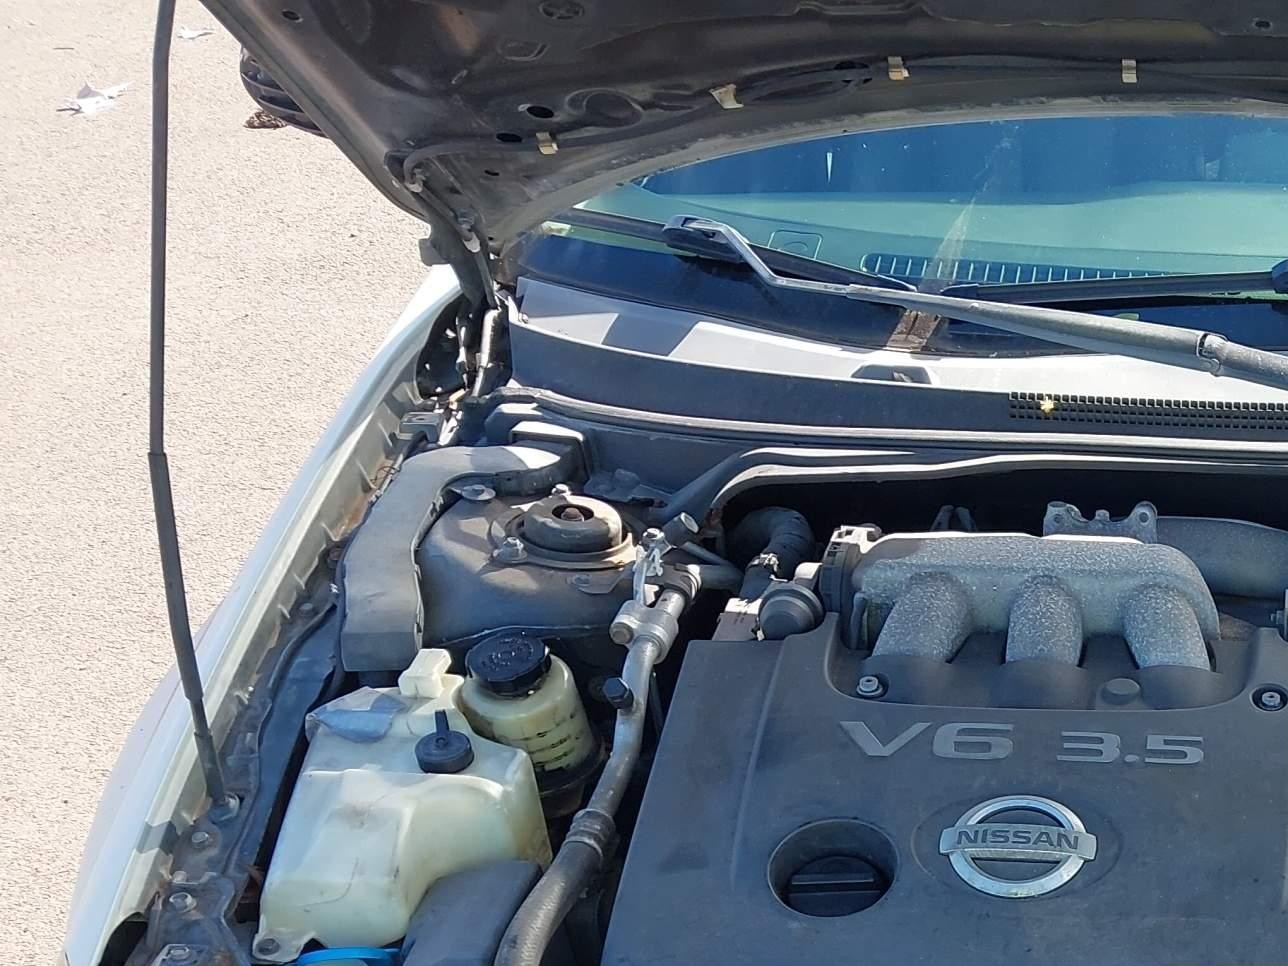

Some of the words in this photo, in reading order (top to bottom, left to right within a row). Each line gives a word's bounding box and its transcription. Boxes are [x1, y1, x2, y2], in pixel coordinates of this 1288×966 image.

[840, 721, 1014, 760] V6
[1056, 730, 1205, 765] 3.5
[955, 827, 1080, 852] NISSAN
